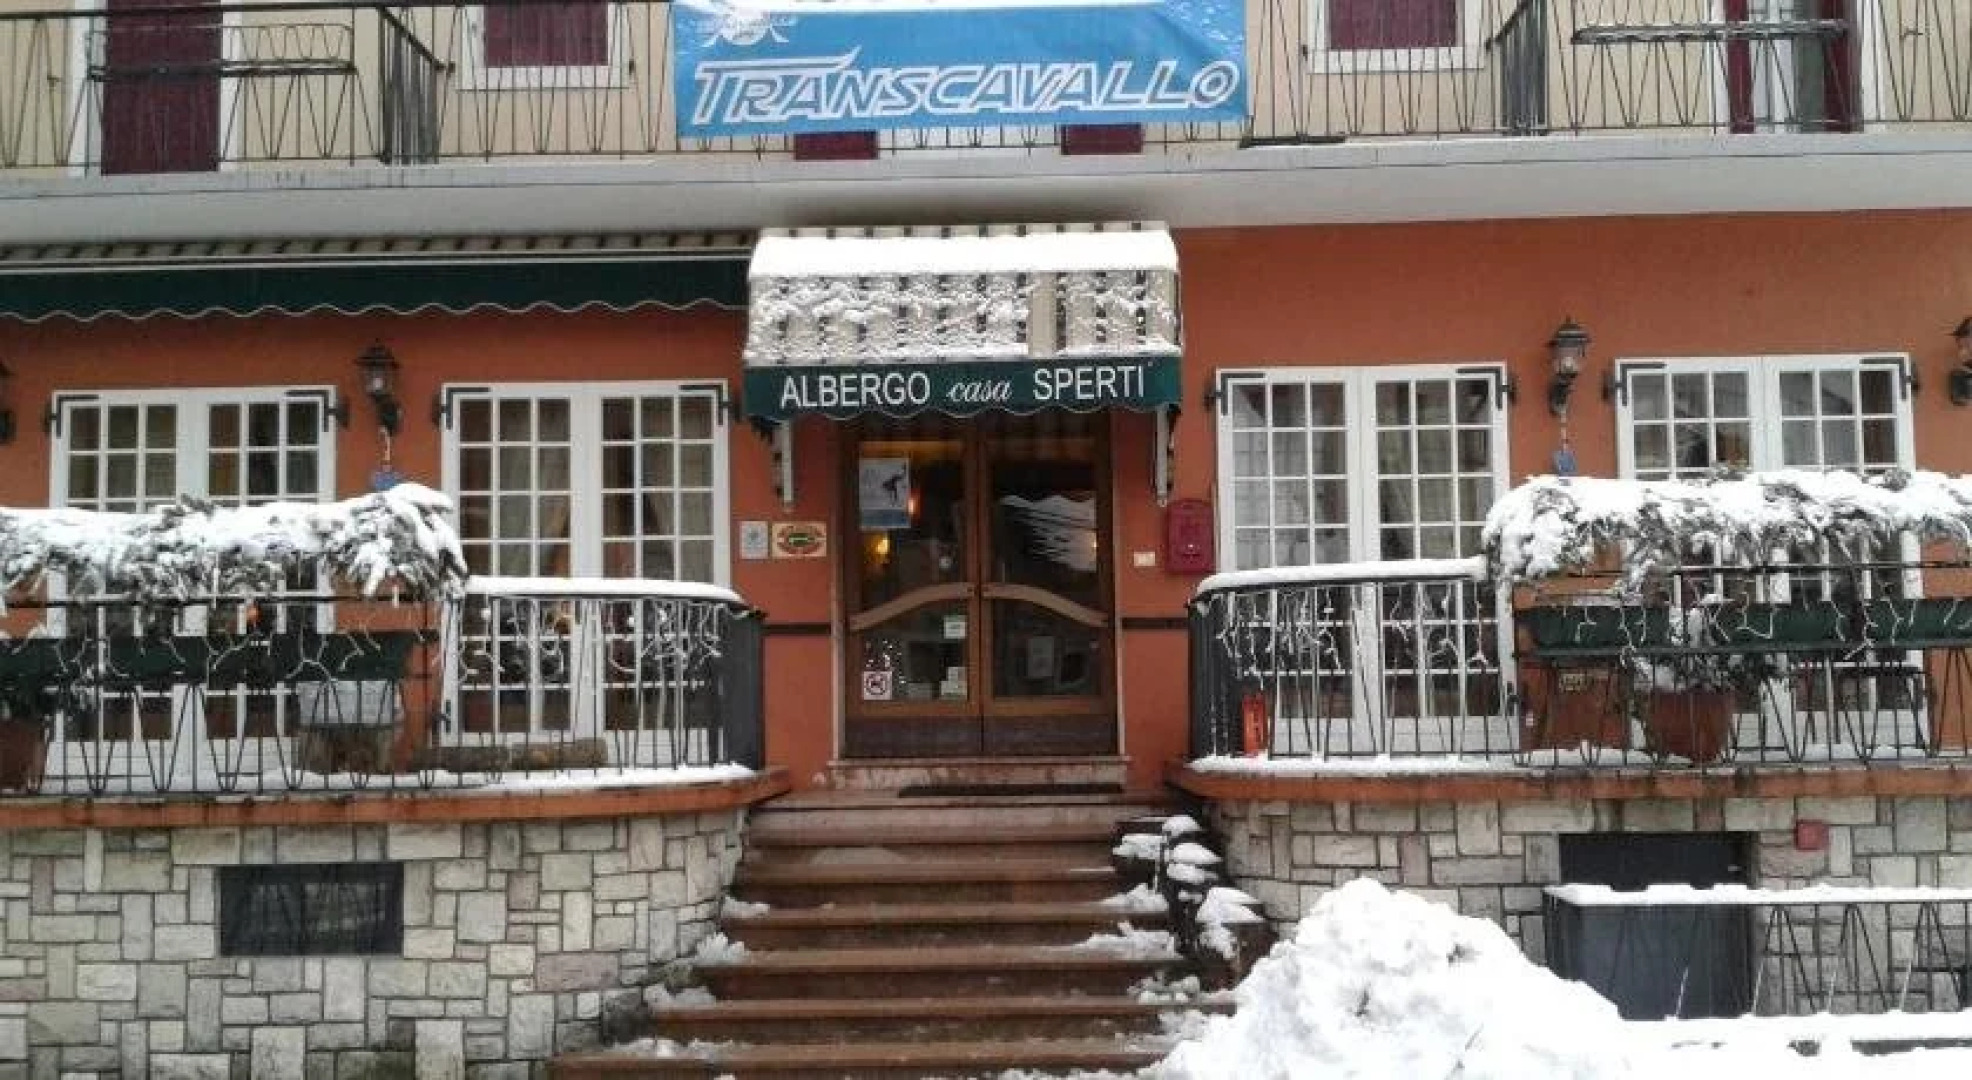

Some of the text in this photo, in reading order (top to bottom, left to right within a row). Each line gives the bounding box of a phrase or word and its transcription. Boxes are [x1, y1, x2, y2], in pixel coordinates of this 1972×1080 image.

[692, 47, 1239, 124] TRANSCAVALLO
[780, 365, 1145, 408] ALBERGO casa SPERTI
